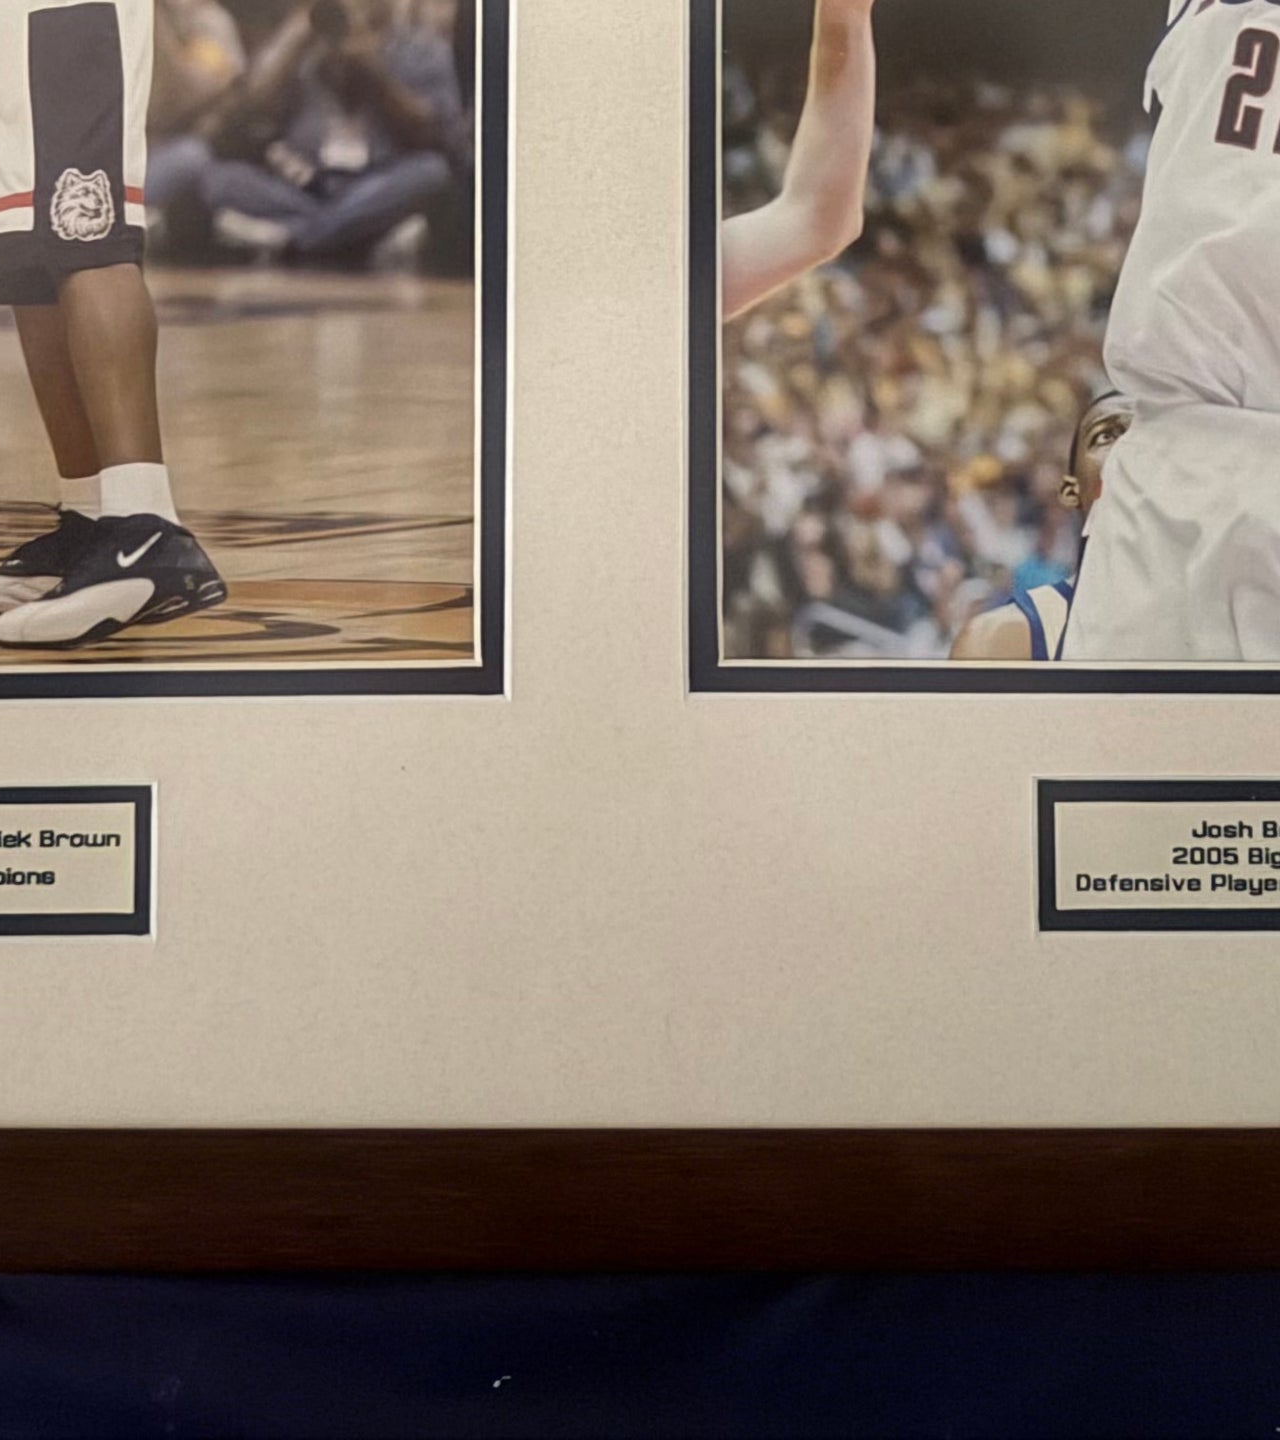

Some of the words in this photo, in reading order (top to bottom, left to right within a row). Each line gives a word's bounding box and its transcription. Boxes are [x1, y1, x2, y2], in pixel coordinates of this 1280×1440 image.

[38, 829, 122, 849] Brown
[1191, 820, 1254, 840] Josh
[1171, 846, 1240, 866] 2005
[1075, 872, 1202, 893] Defensive
